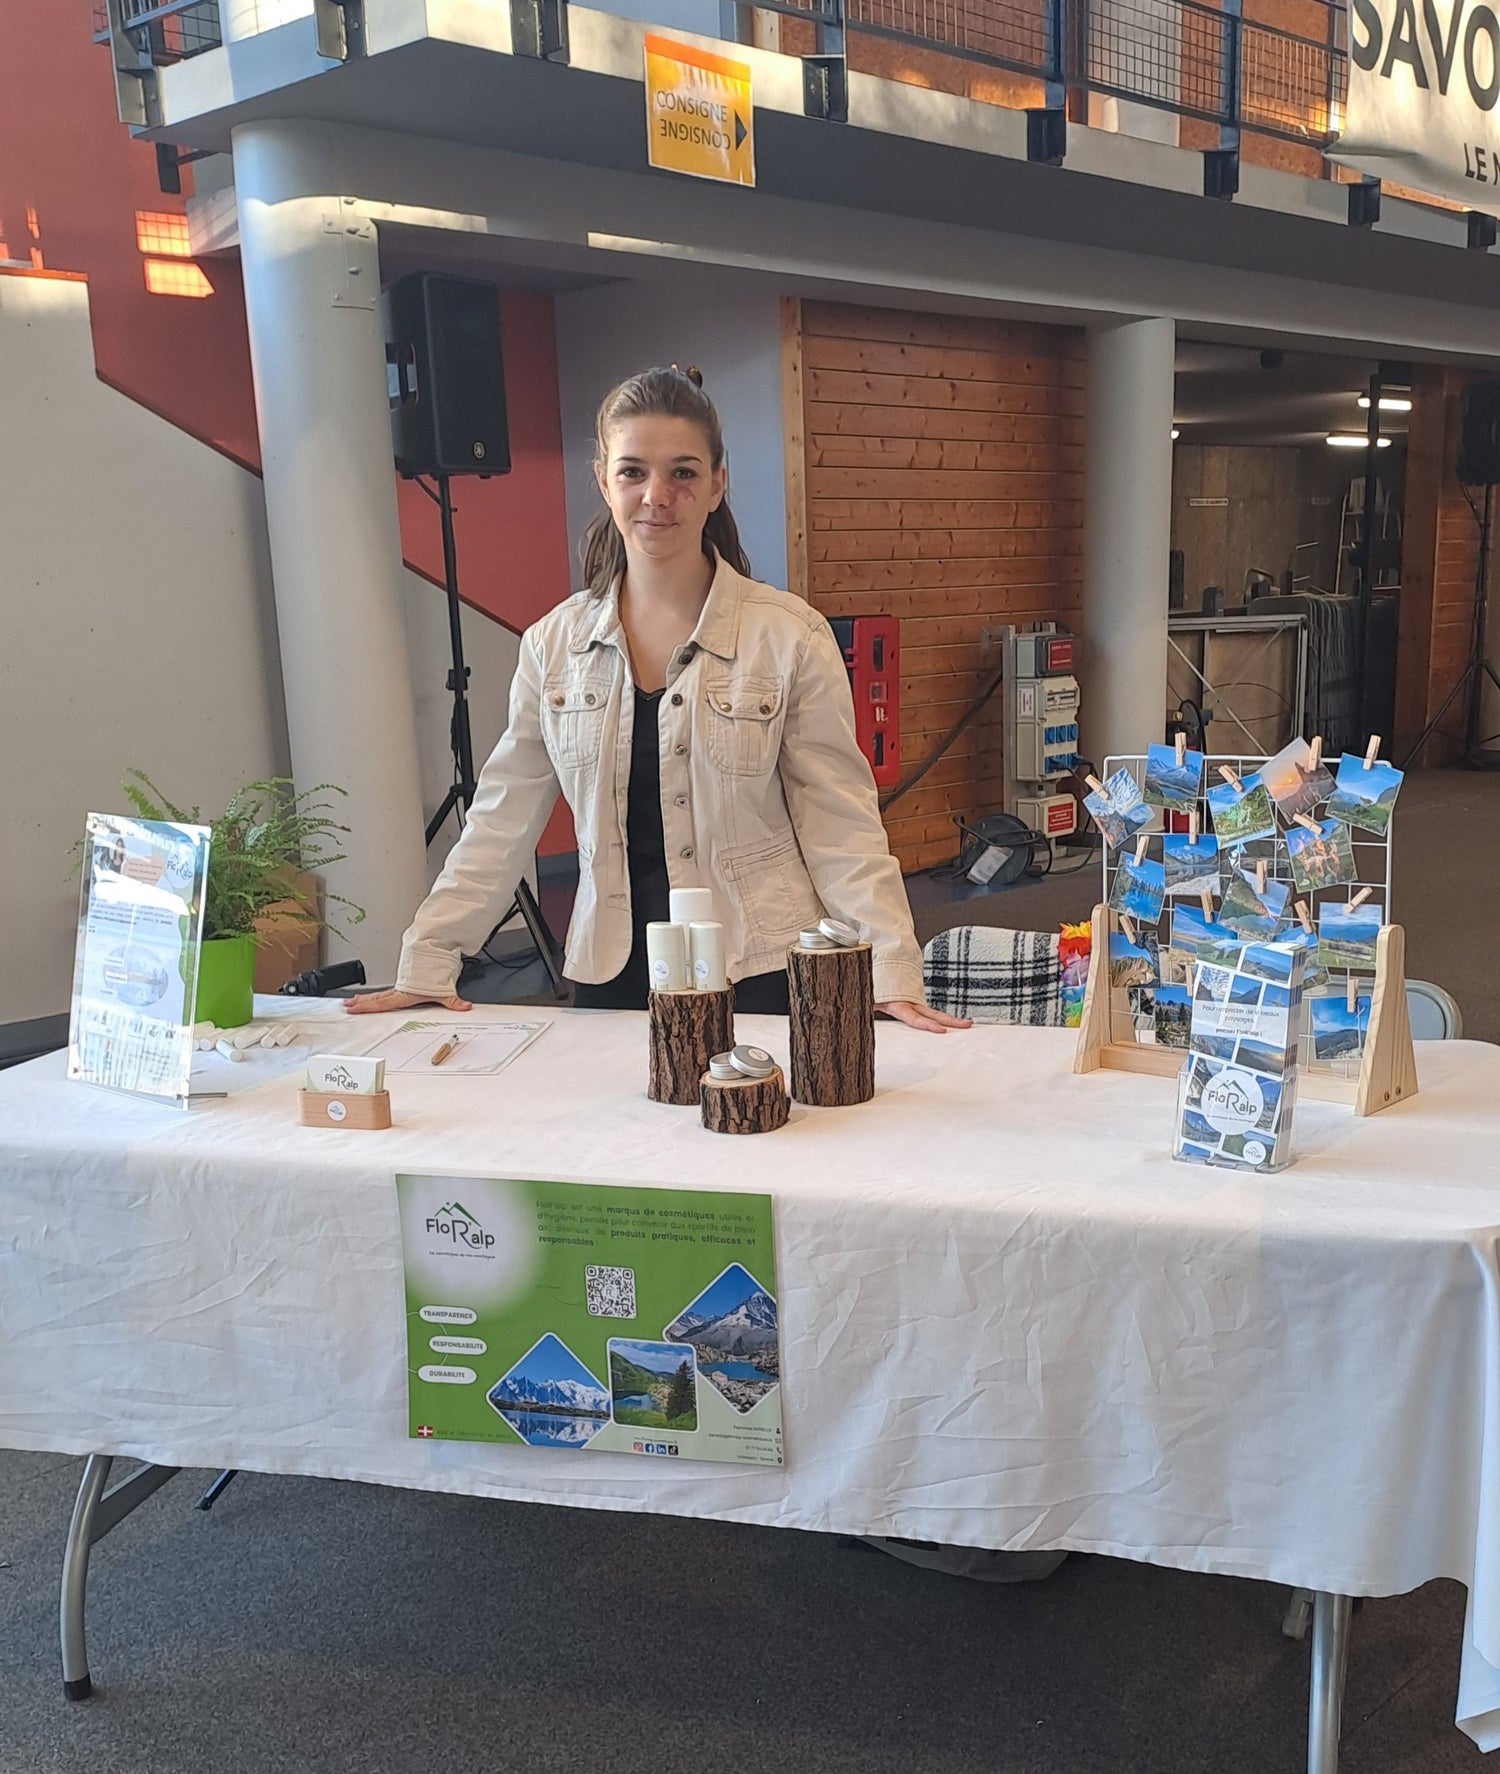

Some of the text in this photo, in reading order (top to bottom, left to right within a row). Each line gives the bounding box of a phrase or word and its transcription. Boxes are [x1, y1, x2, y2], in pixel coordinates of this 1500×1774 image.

[656, 89, 728, 123] CONSIGNE
[659, 118, 731, 150] CONSIGNE
[606, 1206, 641, 1217] marque
[643, 1208, 656, 1217] de
[658, 1209, 716, 1221] cosmétiques
[610, 1229, 646, 1240] produits
[423, 1310, 473, 1320] TRANSPARENCE
